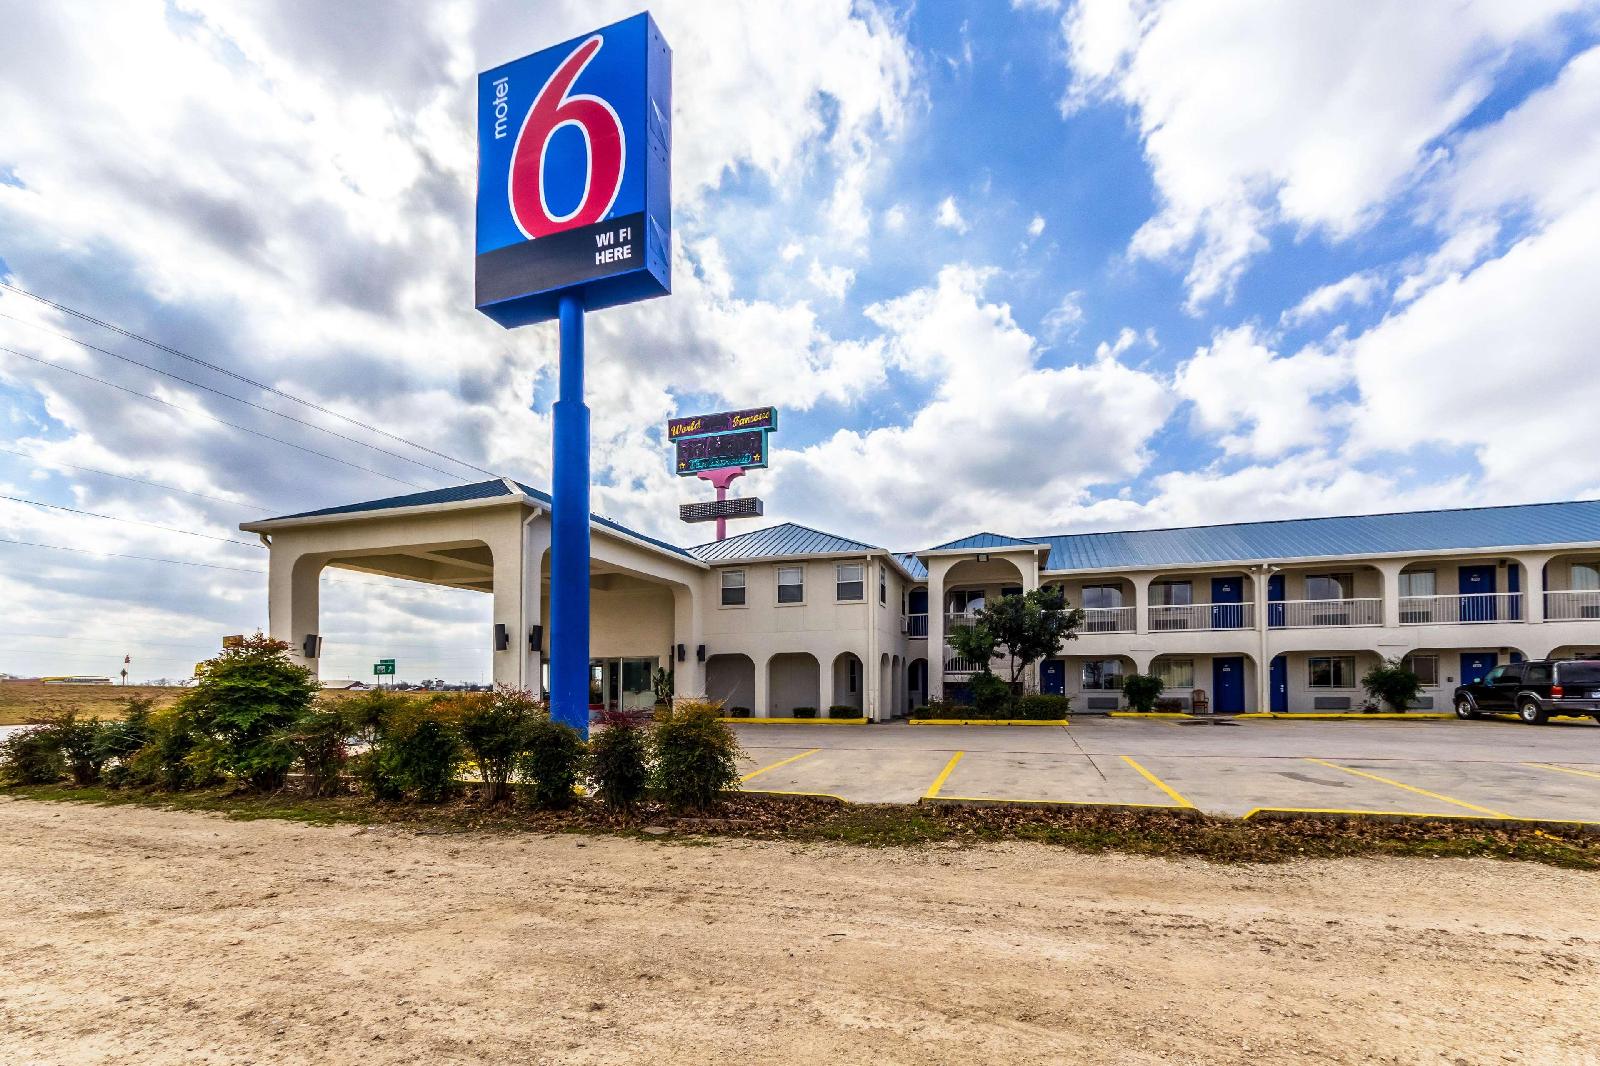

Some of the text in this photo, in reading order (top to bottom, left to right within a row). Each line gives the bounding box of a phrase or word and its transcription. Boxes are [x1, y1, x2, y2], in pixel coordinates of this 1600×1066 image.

[493, 77, 508, 139] motel
[508, 34, 626, 240] 6
[595, 226, 632, 248] WI FI
[595, 244, 632, 265] HERE
[671, 420, 701, 436] World
